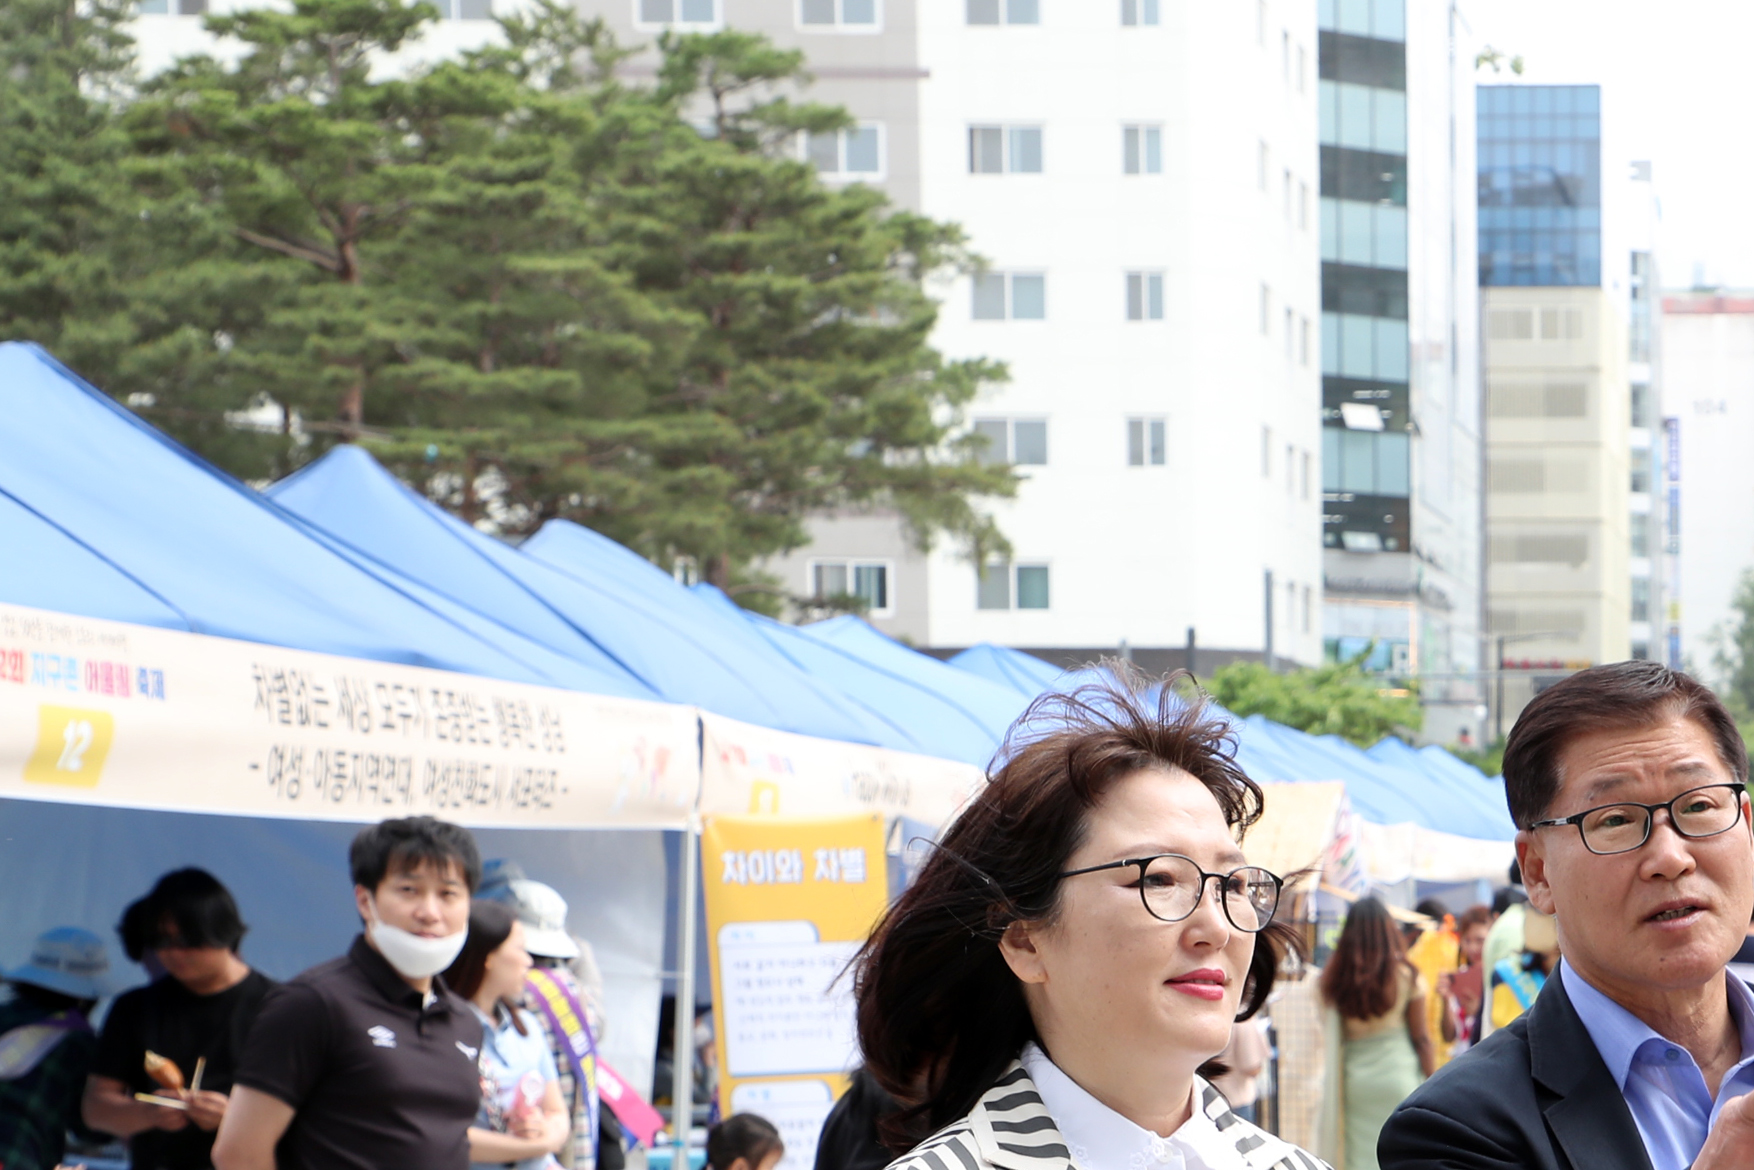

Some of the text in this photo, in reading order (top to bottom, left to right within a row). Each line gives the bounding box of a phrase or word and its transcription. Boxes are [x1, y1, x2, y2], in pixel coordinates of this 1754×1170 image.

[30, 651, 78, 691] 지구촌
[85, 658, 132, 697] 어울림
[137, 666, 165, 700] 축제
[252, 663, 330, 728] 차별없는
[334, 676, 371, 733] 세상
[375, 682, 429, 739] 모두가
[430, 688, 492, 744] 존중받는
[492, 696, 536, 749] 행복한
[56, 718, 93, 772] 12
[720, 846, 867, 886] 차이와 차별
